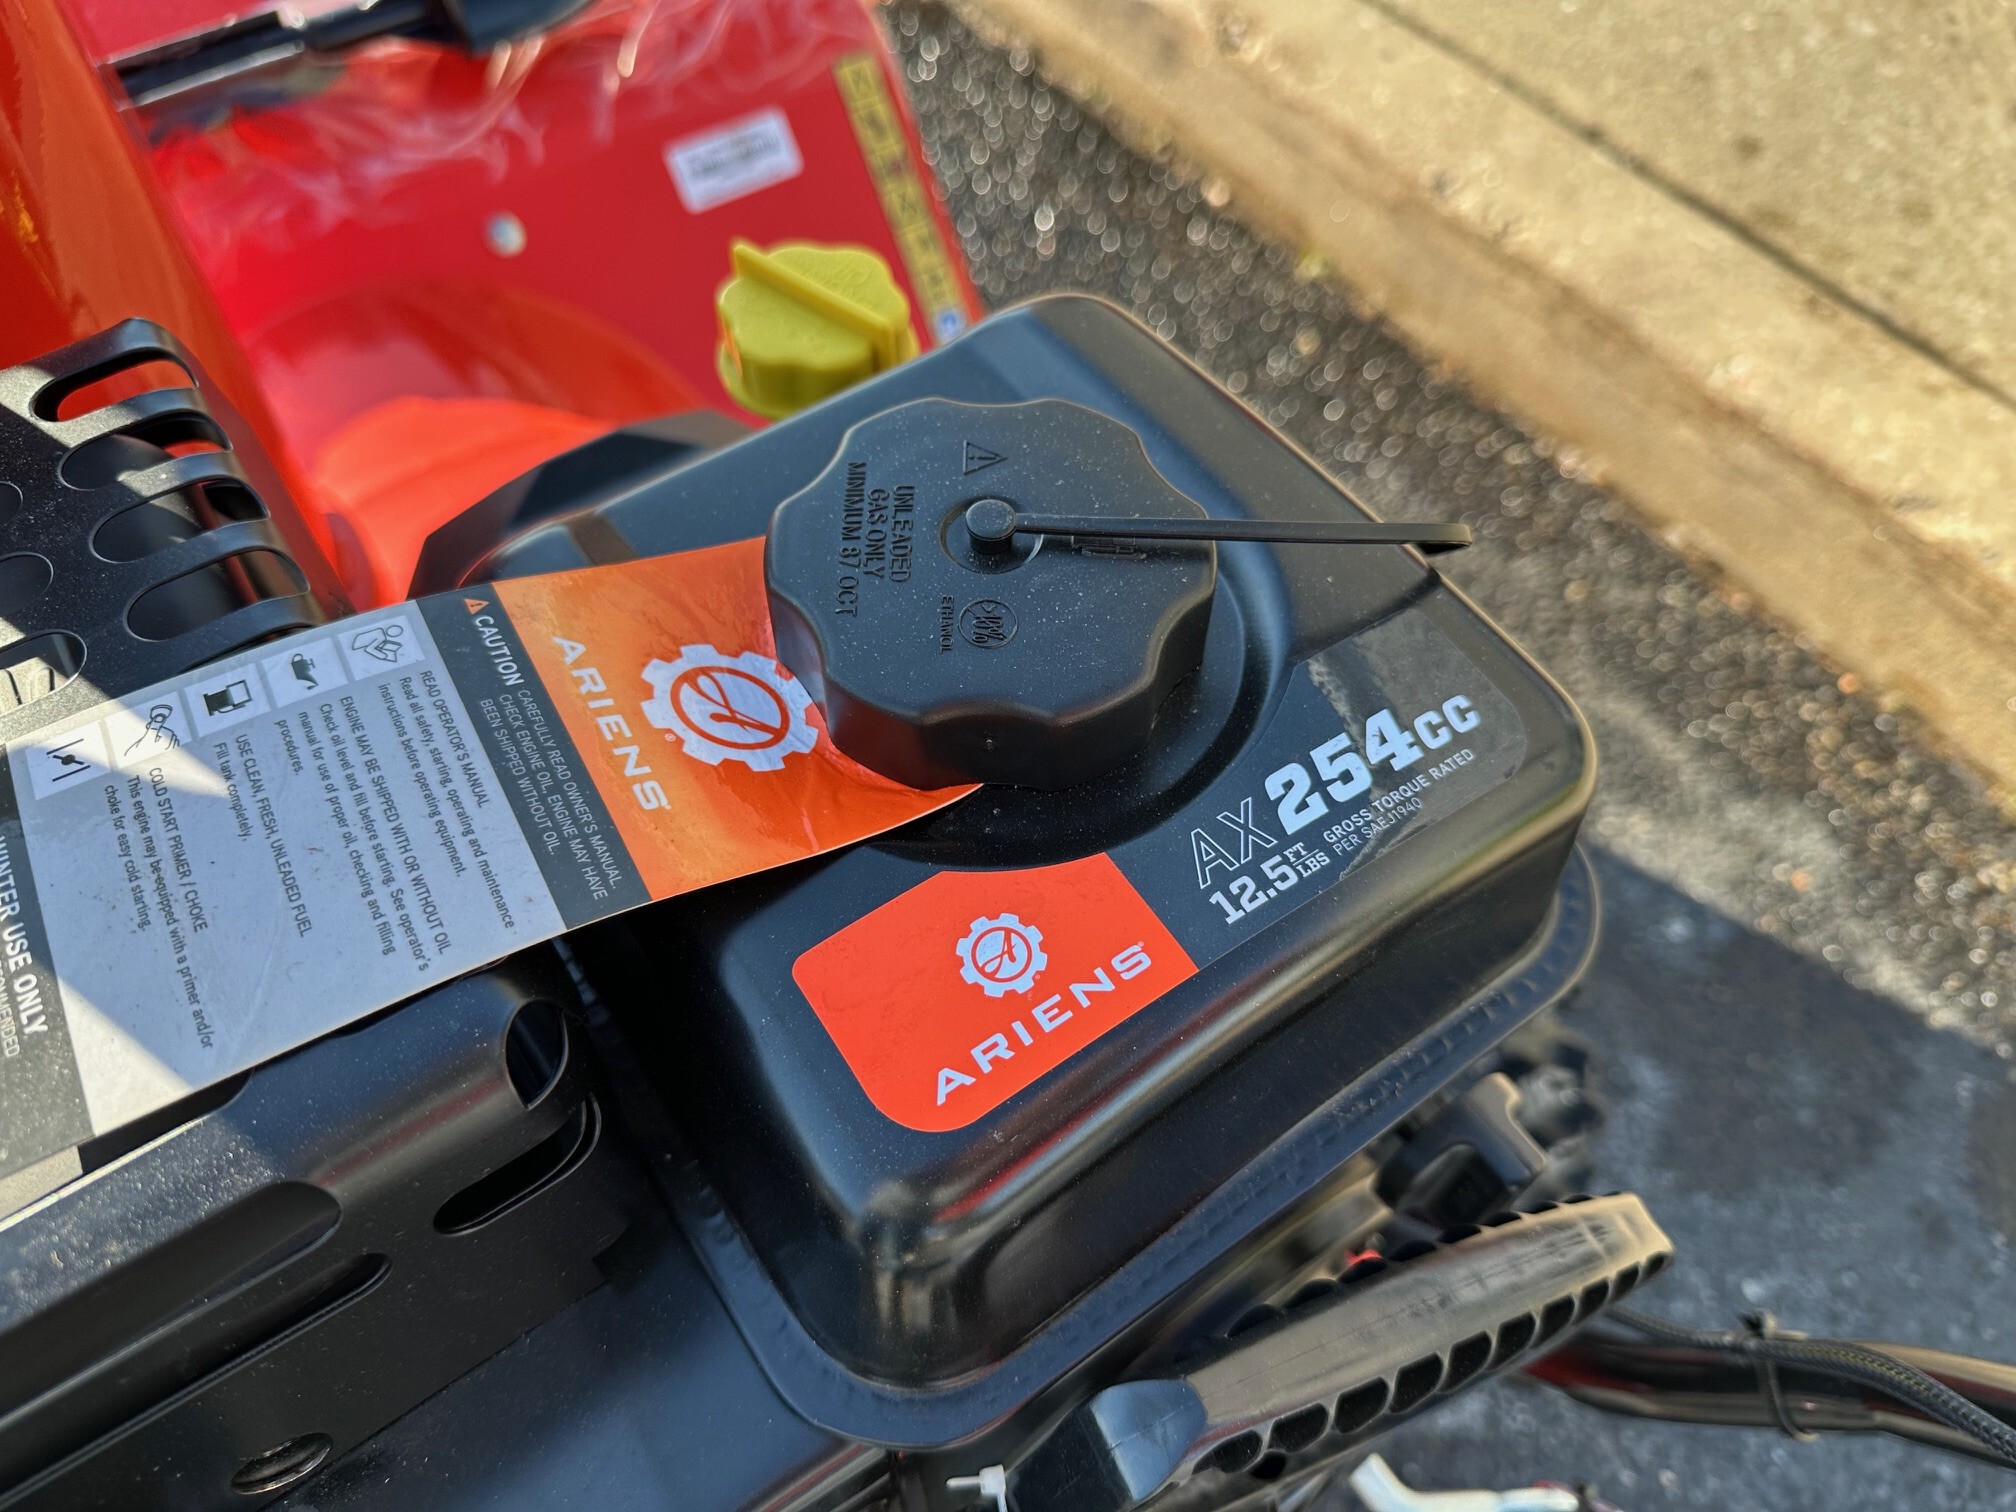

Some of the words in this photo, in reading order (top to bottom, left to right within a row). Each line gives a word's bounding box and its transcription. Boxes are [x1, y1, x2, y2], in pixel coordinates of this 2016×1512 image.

[842, 462, 867, 544] MINIMUM
[867, 488, 890, 526] GAS
[888, 484, 915, 583] UNLEADED
[838, 547, 861, 571] 87
[863, 528, 887, 579] ONLY
[836, 575, 858, 617] OCT
[940, 595, 954, 654] ETHANOL
[474, 615, 525, 686] CAUTION
[399, 676, 419, 700] Read
[319, 703, 340, 733] Check
[339, 695, 365, 734] ENGINE
[409, 702, 425, 714] all
[552, 635, 668, 811] ARIENS
[235, 733, 254, 758] USE
[298, 711, 322, 746] manual
[330, 734, 346, 747] oil
[354, 733, 375, 756] MAY
[414, 714, 435, 747] safety,
[419, 670, 441, 698] READ
[432, 698, 470, 762] OPERATOR'S
[460, 761, 490, 809] MANUAL
[213, 742, 230, 760] Fill
[311, 746, 324, 761] for
[335, 746, 355, 771] level
[364, 757, 381, 775] BE
[429, 747, 453, 788] starting,
[126, 774, 143, 799] This
[148, 767, 168, 797] COLD
[219, 759, 236, 783] tank
[243, 757, 266, 798] CLEAN,
[316, 763, 331, 781] use
[324, 783, 340, 794] of
[344, 772, 363, 792] and
[378, 682, 408, 738] instructions
[400, 737, 421, 770] before
[413, 771, 442, 819] operating
[434, 819, 467, 877] equipment.
[480, 698, 503, 728] BEEN
[494, 729, 526, 776] SHIPPED
[517, 776, 553, 828] WITHOUT
[542, 831, 561, 855] OIL.
[104, 784, 122, 815] choke
[352, 792, 369, 807] fill
[371, 774, 400, 823] SHIPPED
[498, 694, 525, 729] CHECK
[516, 730, 546, 770] ENGINE
[536, 771, 554, 794] OIL,
[547, 794, 579, 837] ENGINE
[568, 838, 592, 863] MAY
[581, 865, 608, 900] HAVE
[517, 689, 556, 746] CAREFULLY
[547, 749, 572, 780] READ
[563, 781, 598, 834] OWNER'S
[589, 834, 622, 889] MANUAL.
[1323, 808, 1373, 844] GROSS
[1372, 775, 1430, 811] TORQUE
[1429, 748, 1475, 780] RATED
[112, 815, 126, 831] for
[132, 800, 151, 834] engine
[157, 797, 179, 833] START
[255, 797, 279, 840] FRESH,
[324, 795, 349, 828] proper
[358, 806, 379, 841] before
[446, 789, 476, 837] operating
[1333, 836, 1362, 856] PER
[1360, 797, 1424, 837] SAEJ1940
[117, 833, 132, 858] easy
[142, 835, 158, 858] may
[342, 831, 358, 849] oil,
[390, 822, 413, 855] WITH
[468, 838, 488, 858] and
[1190, 797, 1278, 889] AX
[1283, 841, 1307, 864] FT
[124, 859, 142, 883] cold
[167, 834, 192, 880] PRIMER
[270, 838, 302, 903] UNLEADED
[349, 849, 374, 898] checking
[372, 842, 396, 888] starting.
[403, 855, 420, 874] OR
[1296, 851, 1330, 879] LBS
[390, 888, 406, 912] See
[410, 873, 444, 930] WITHOUT
[477, 859, 515, 929] maintenance
[1209, 854, 1299, 924] 12.5
[130, 884, 151, 931] starting.
[184, 889, 208, 933] CHOKE
[291, 903, 313, 938] FUEL
[367, 898, 387, 921] and
[2, 922, 33, 973] USE
[169, 927, 187, 954] with
[375, 921, 396, 956] filling
[397, 913, 431, 971] operator's
[433, 932, 452, 955] OIL
[176, 954, 187, 965] a
[175, 965, 200, 1005] primer
[13, 973, 48, 1035] ONLY
[192, 1008, 215, 1048] and/or
[937, 943, 1152, 1106] ARIENS
